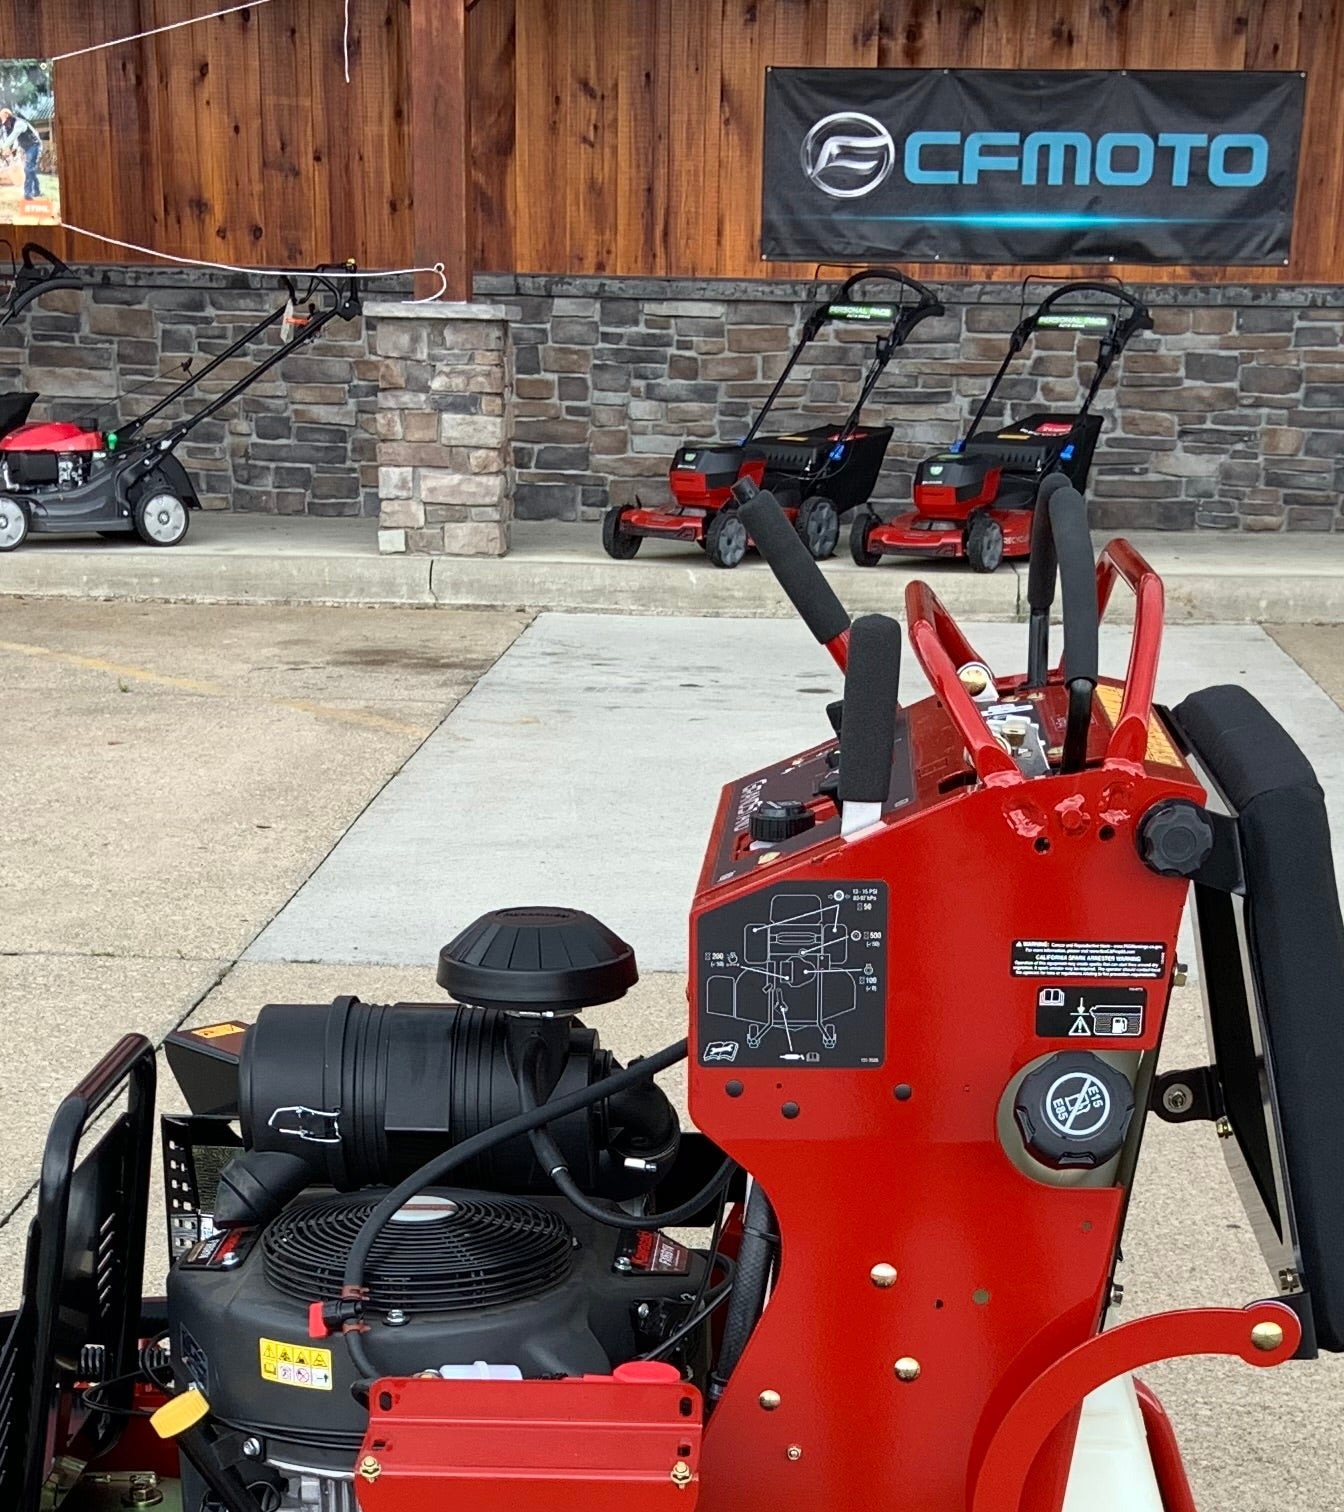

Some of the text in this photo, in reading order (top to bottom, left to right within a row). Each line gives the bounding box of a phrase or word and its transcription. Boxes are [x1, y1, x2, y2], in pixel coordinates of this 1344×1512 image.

[903, 130, 1270, 188] CFMOTO
[24, 204, 51, 214] STIHL
[1088, 1085, 1104, 1109] E15
[1052, 1098, 1069, 1122] E85
